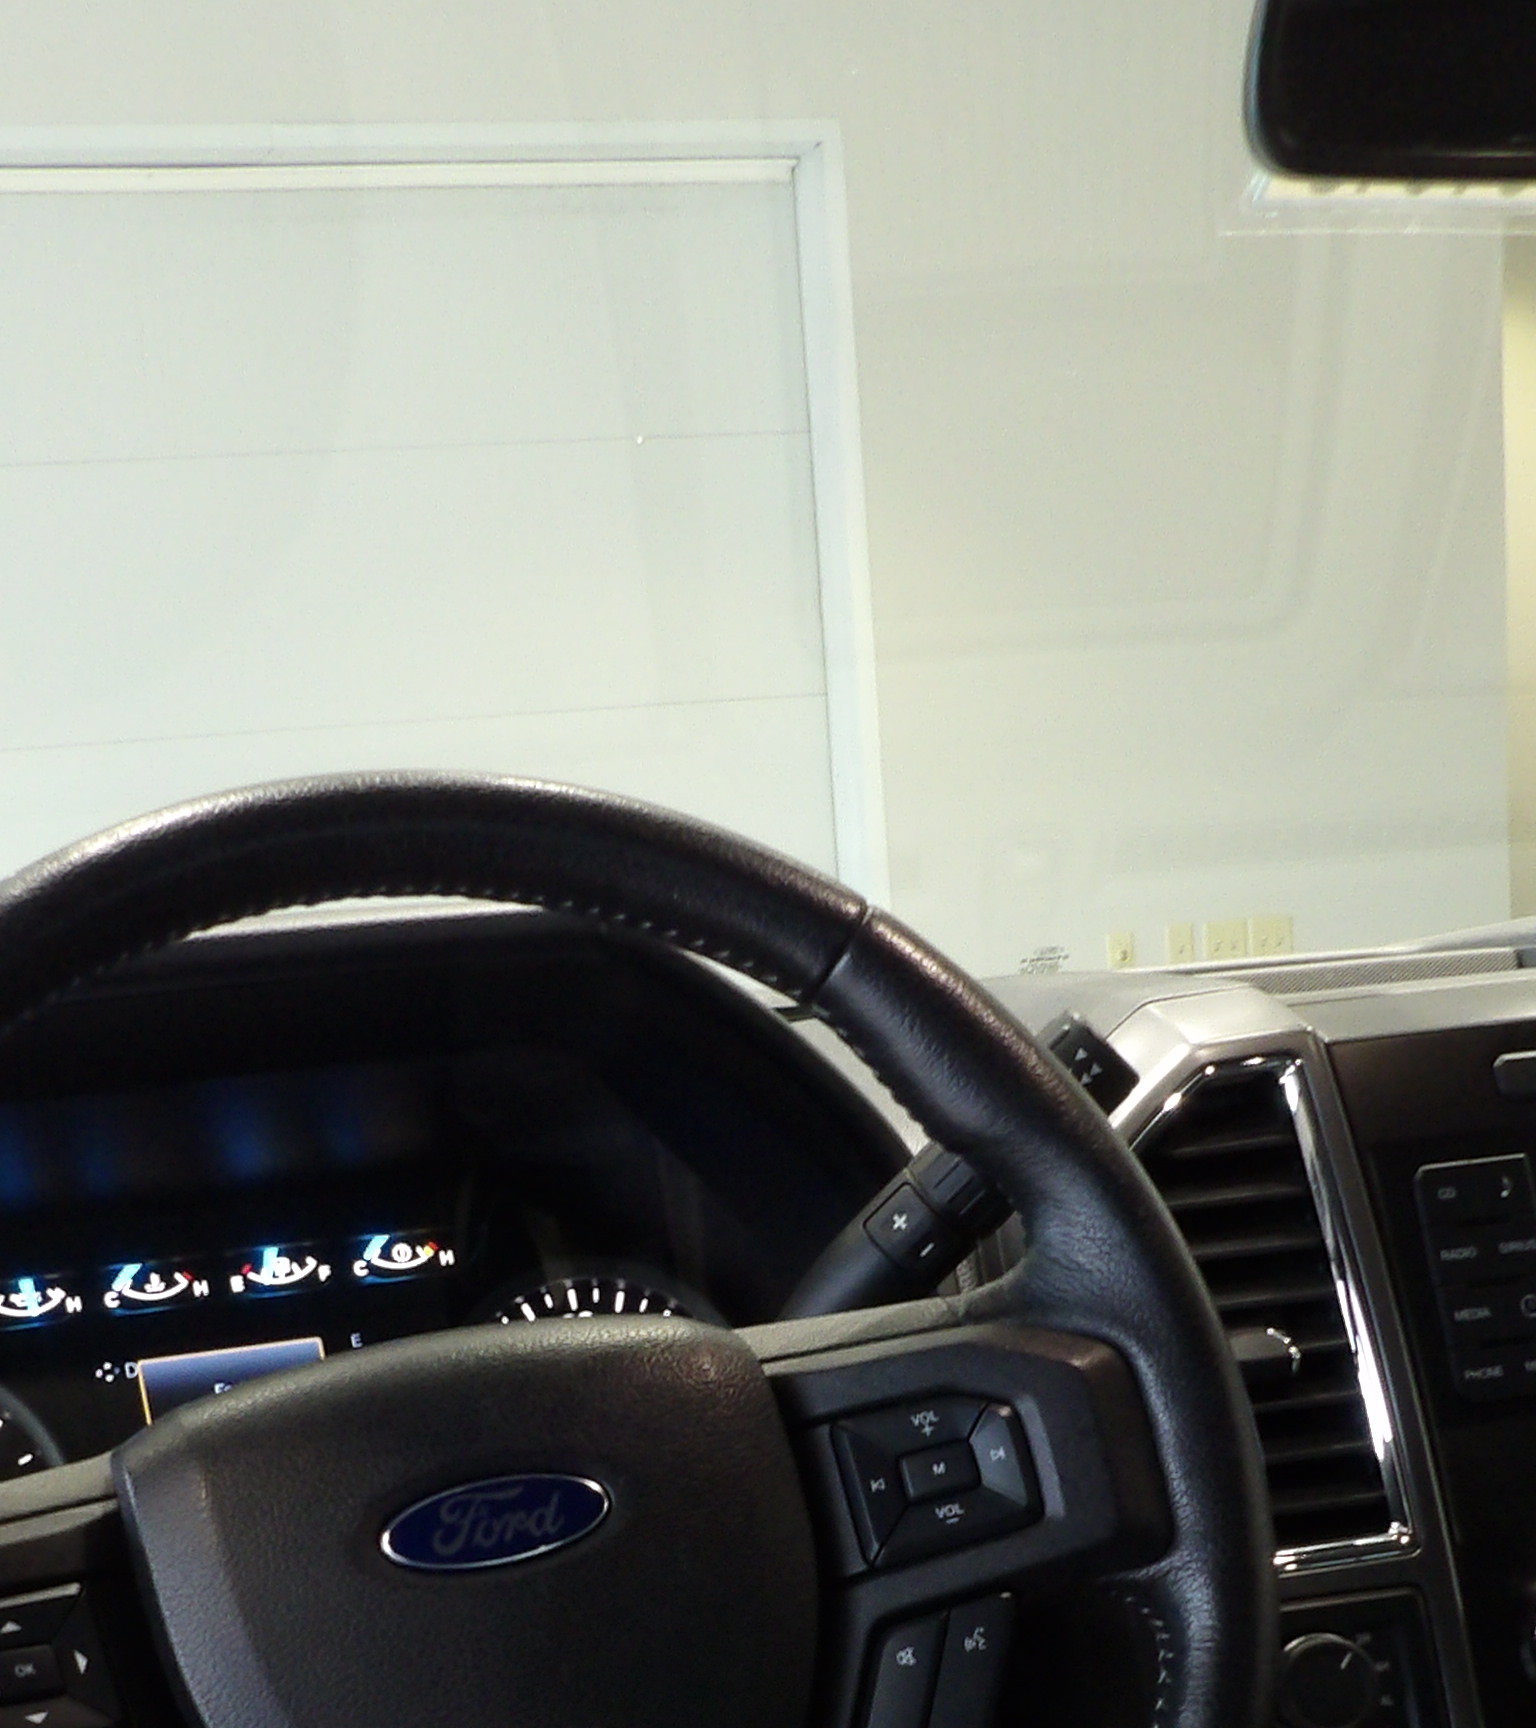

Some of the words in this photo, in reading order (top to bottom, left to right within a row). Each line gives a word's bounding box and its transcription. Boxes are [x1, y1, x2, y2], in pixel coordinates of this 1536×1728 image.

[438, 1248, 455, 1266] H
[1439, 1246, 1479, 1261] RADIO
[317, 1265, 332, 1282] F
[353, 1260, 369, 1277] C
[193, 1280, 209, 1297] H
[231, 1276, 246, 1293] E
[67, 1295, 82, 1313] H
[104, 1292, 120, 1308] C
[1453, 1307, 1493, 1322] MEDIA
[1464, 1365, 1504, 1380] PHONE
[911, 1410, 939, 1427] VOL
[932, 1461, 946, 1475] M
[935, 1503, 964, 1519] VOL
[433, 1485, 565, 1556] Ford
[14, 1662, 37, 1678] OK
